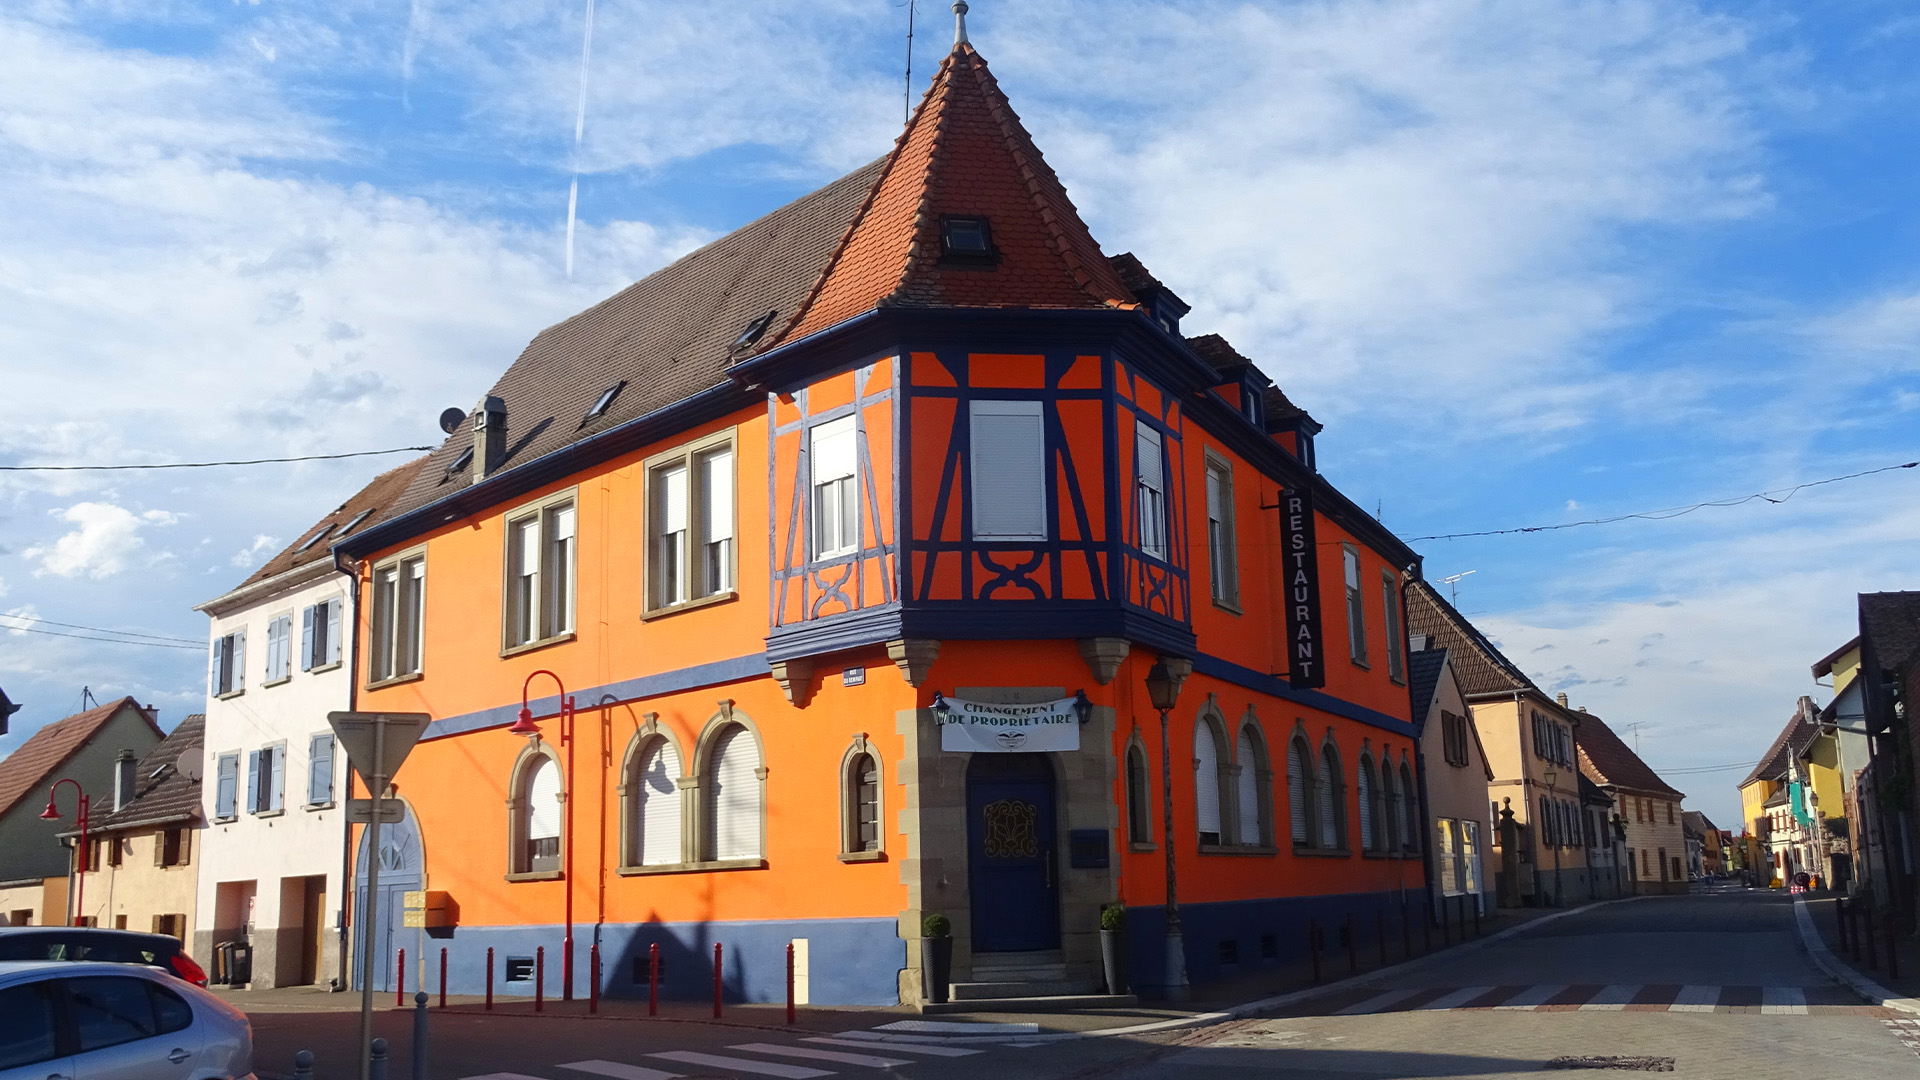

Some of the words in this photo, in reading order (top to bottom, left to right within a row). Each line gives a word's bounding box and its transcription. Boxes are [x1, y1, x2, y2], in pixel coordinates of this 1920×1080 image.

[1289, 497, 1312, 678] RESTAURANT
[963, 702, 1056, 716] CHANGEMENT
[948, 714, 966, 725] DE
[970, 713, 1073, 727] PROPRIÉTAIRE
